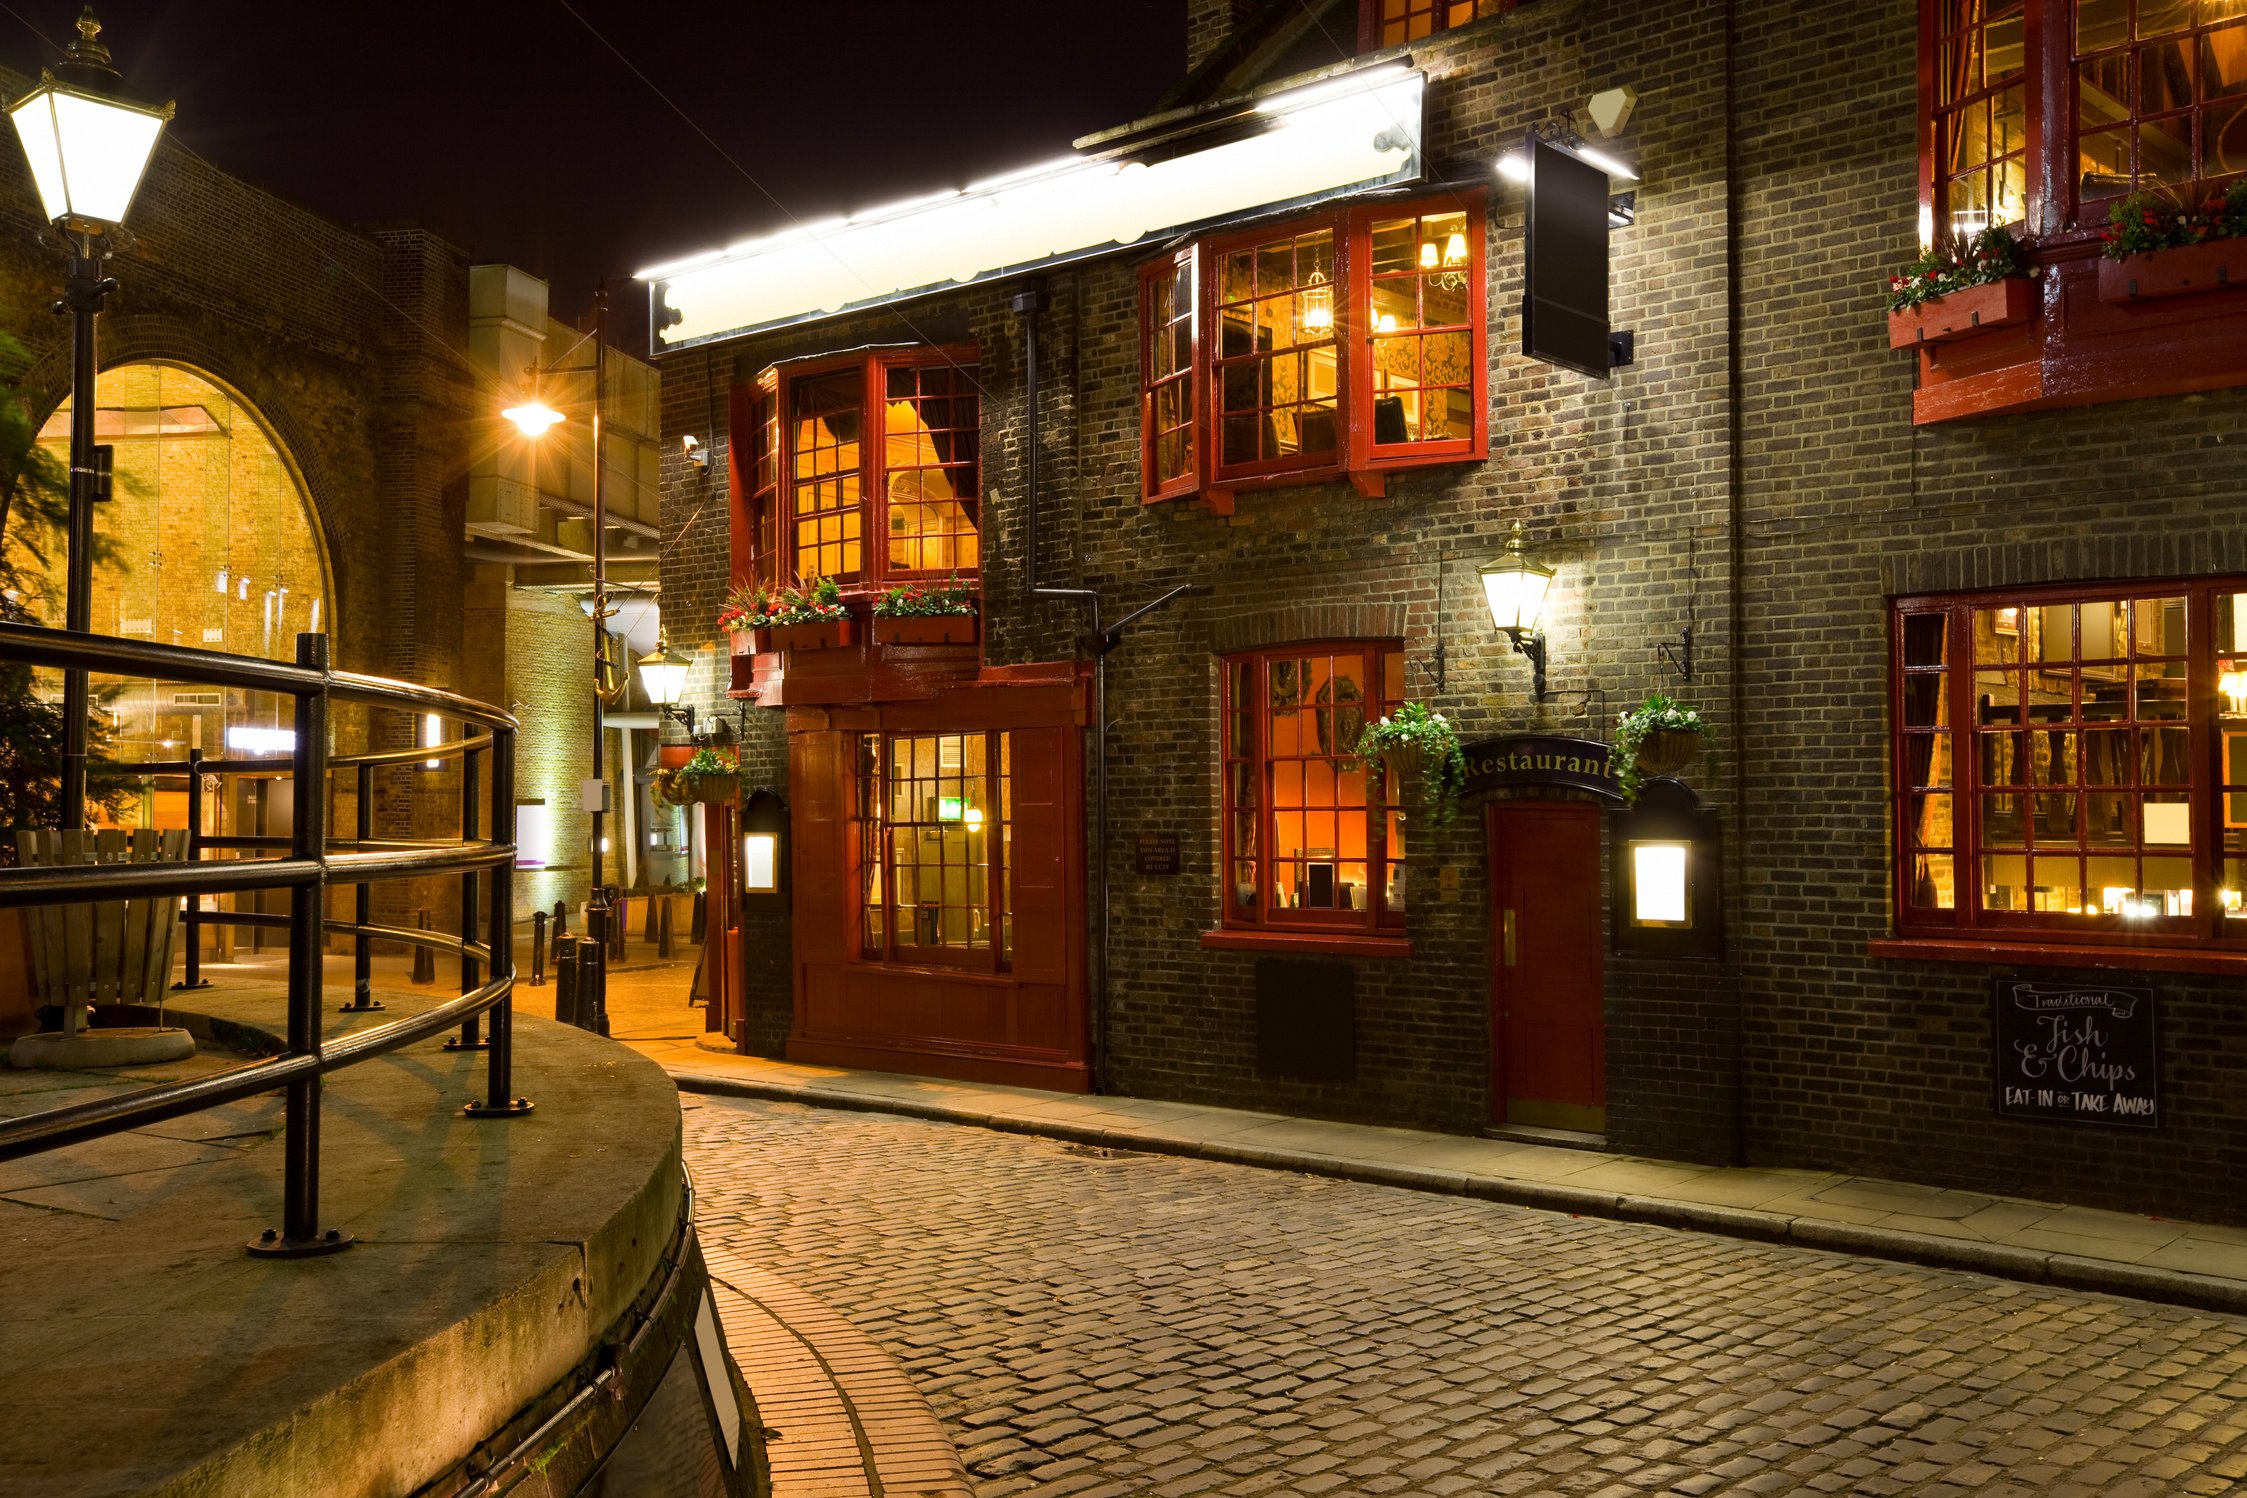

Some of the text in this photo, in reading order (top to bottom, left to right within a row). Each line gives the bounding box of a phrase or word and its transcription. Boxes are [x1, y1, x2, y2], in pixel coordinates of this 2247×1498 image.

[1463, 751, 1615, 779] Restaurant
[2027, 992, 2115, 1009] Traditional
[2036, 1014, 2109, 1054] Fish
[2013, 1039, 2136, 1091] & Chips
[2005, 1086, 2155, 1116] EAT-IN OR TAKE AWAY
